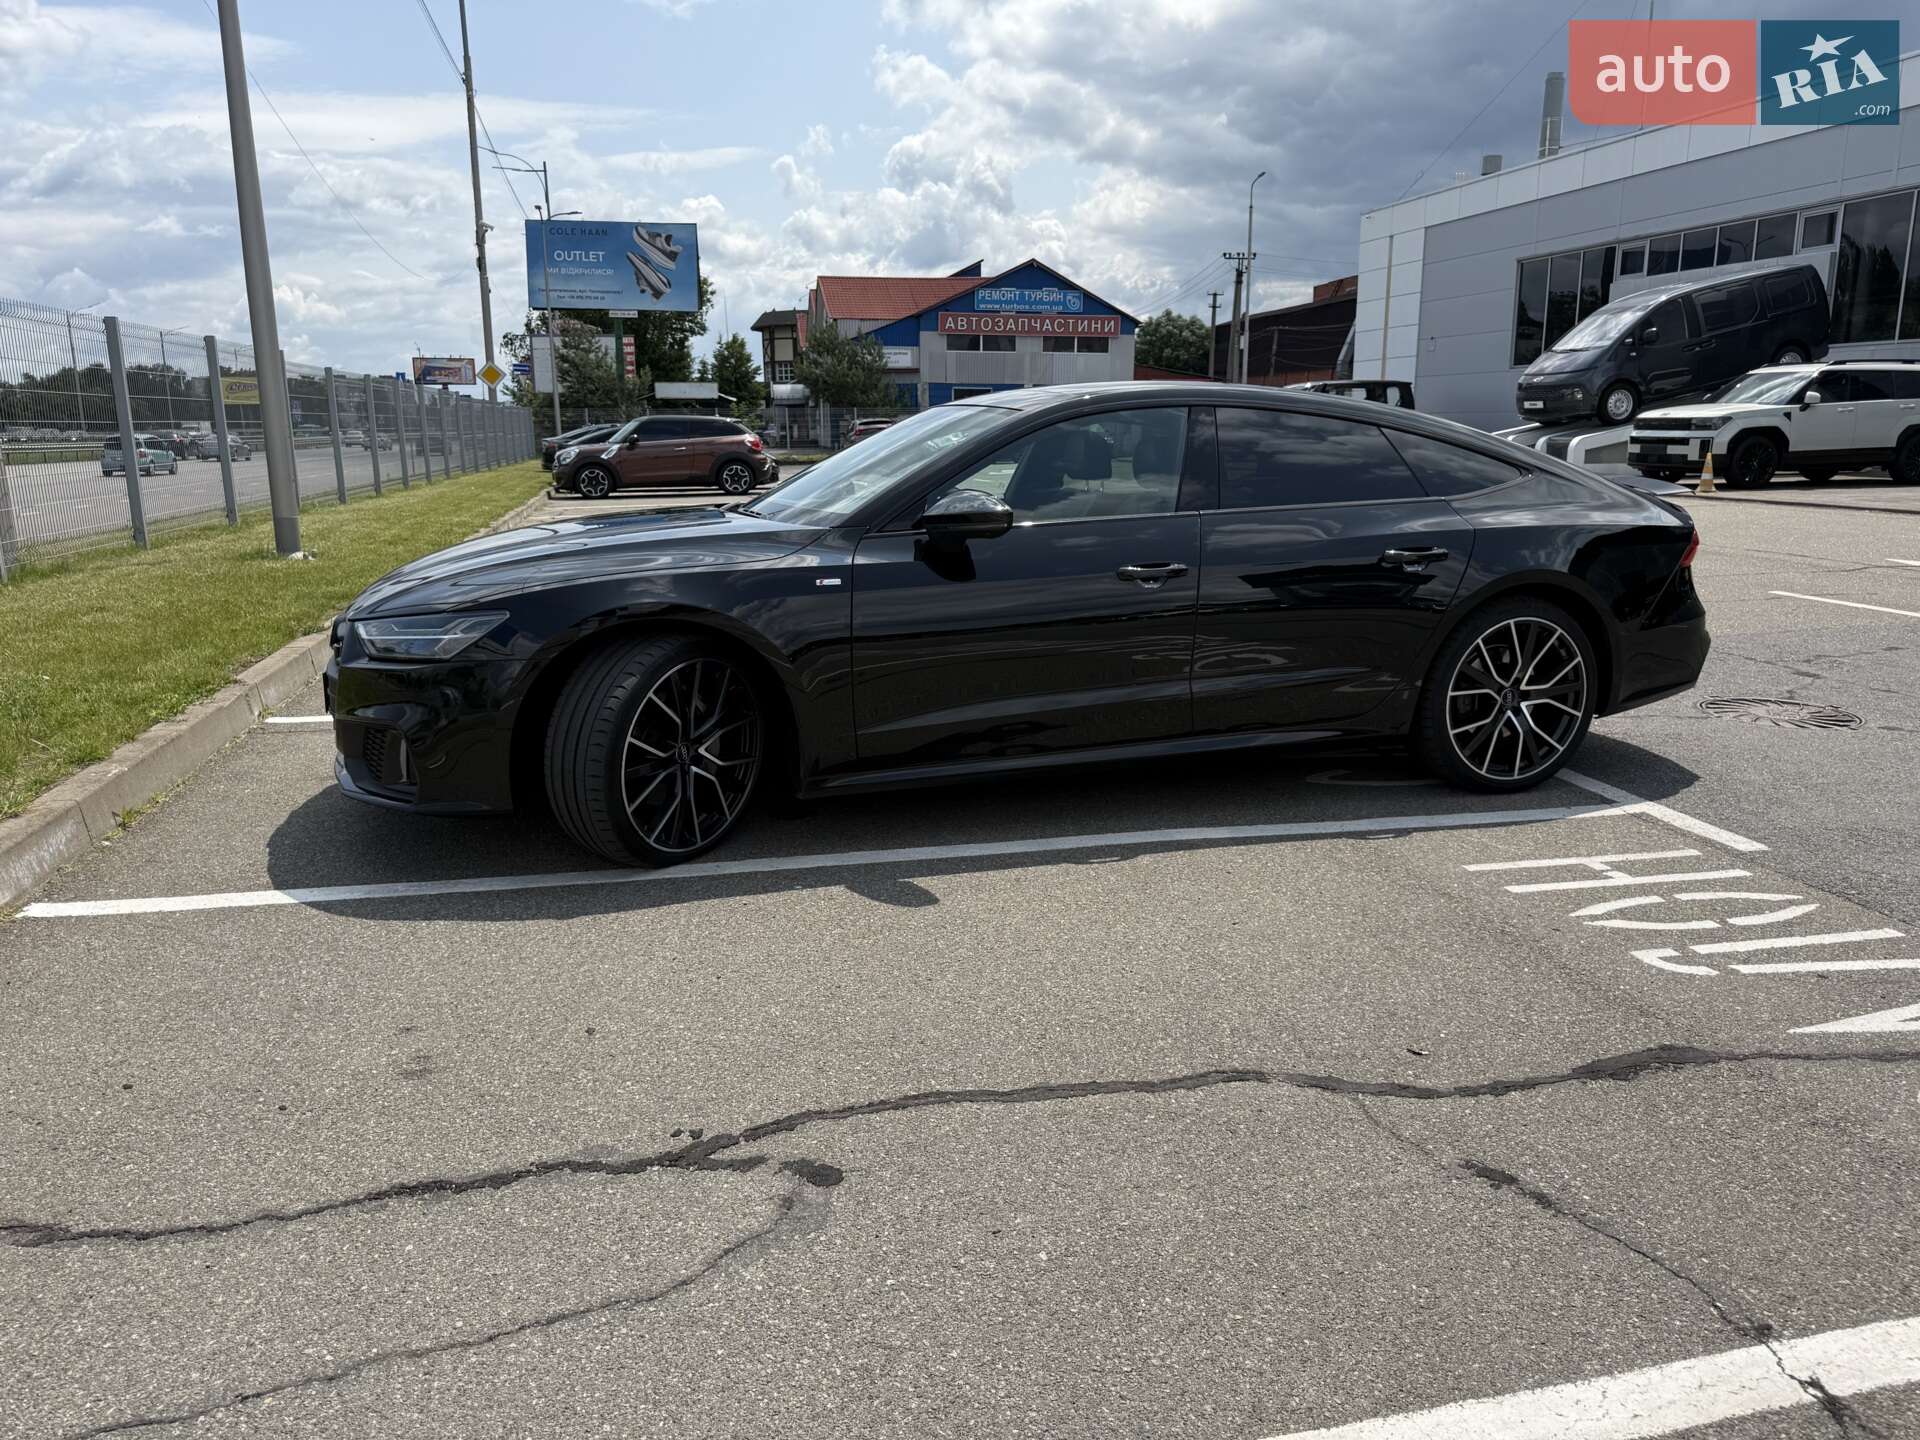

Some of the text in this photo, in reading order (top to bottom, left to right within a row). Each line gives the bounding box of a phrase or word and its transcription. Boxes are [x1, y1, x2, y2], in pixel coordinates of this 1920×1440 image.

[549, 227, 608, 237] COLE HAAN
[554, 250, 606, 263] OUTLET
[978, 290, 1064, 303] РЕМОНТ ТУРБИН
[979, 303, 1063, 312] www.turbos.com.ua
[945, 316, 1115, 333] АВТОЗАПЧАСТИНИ
